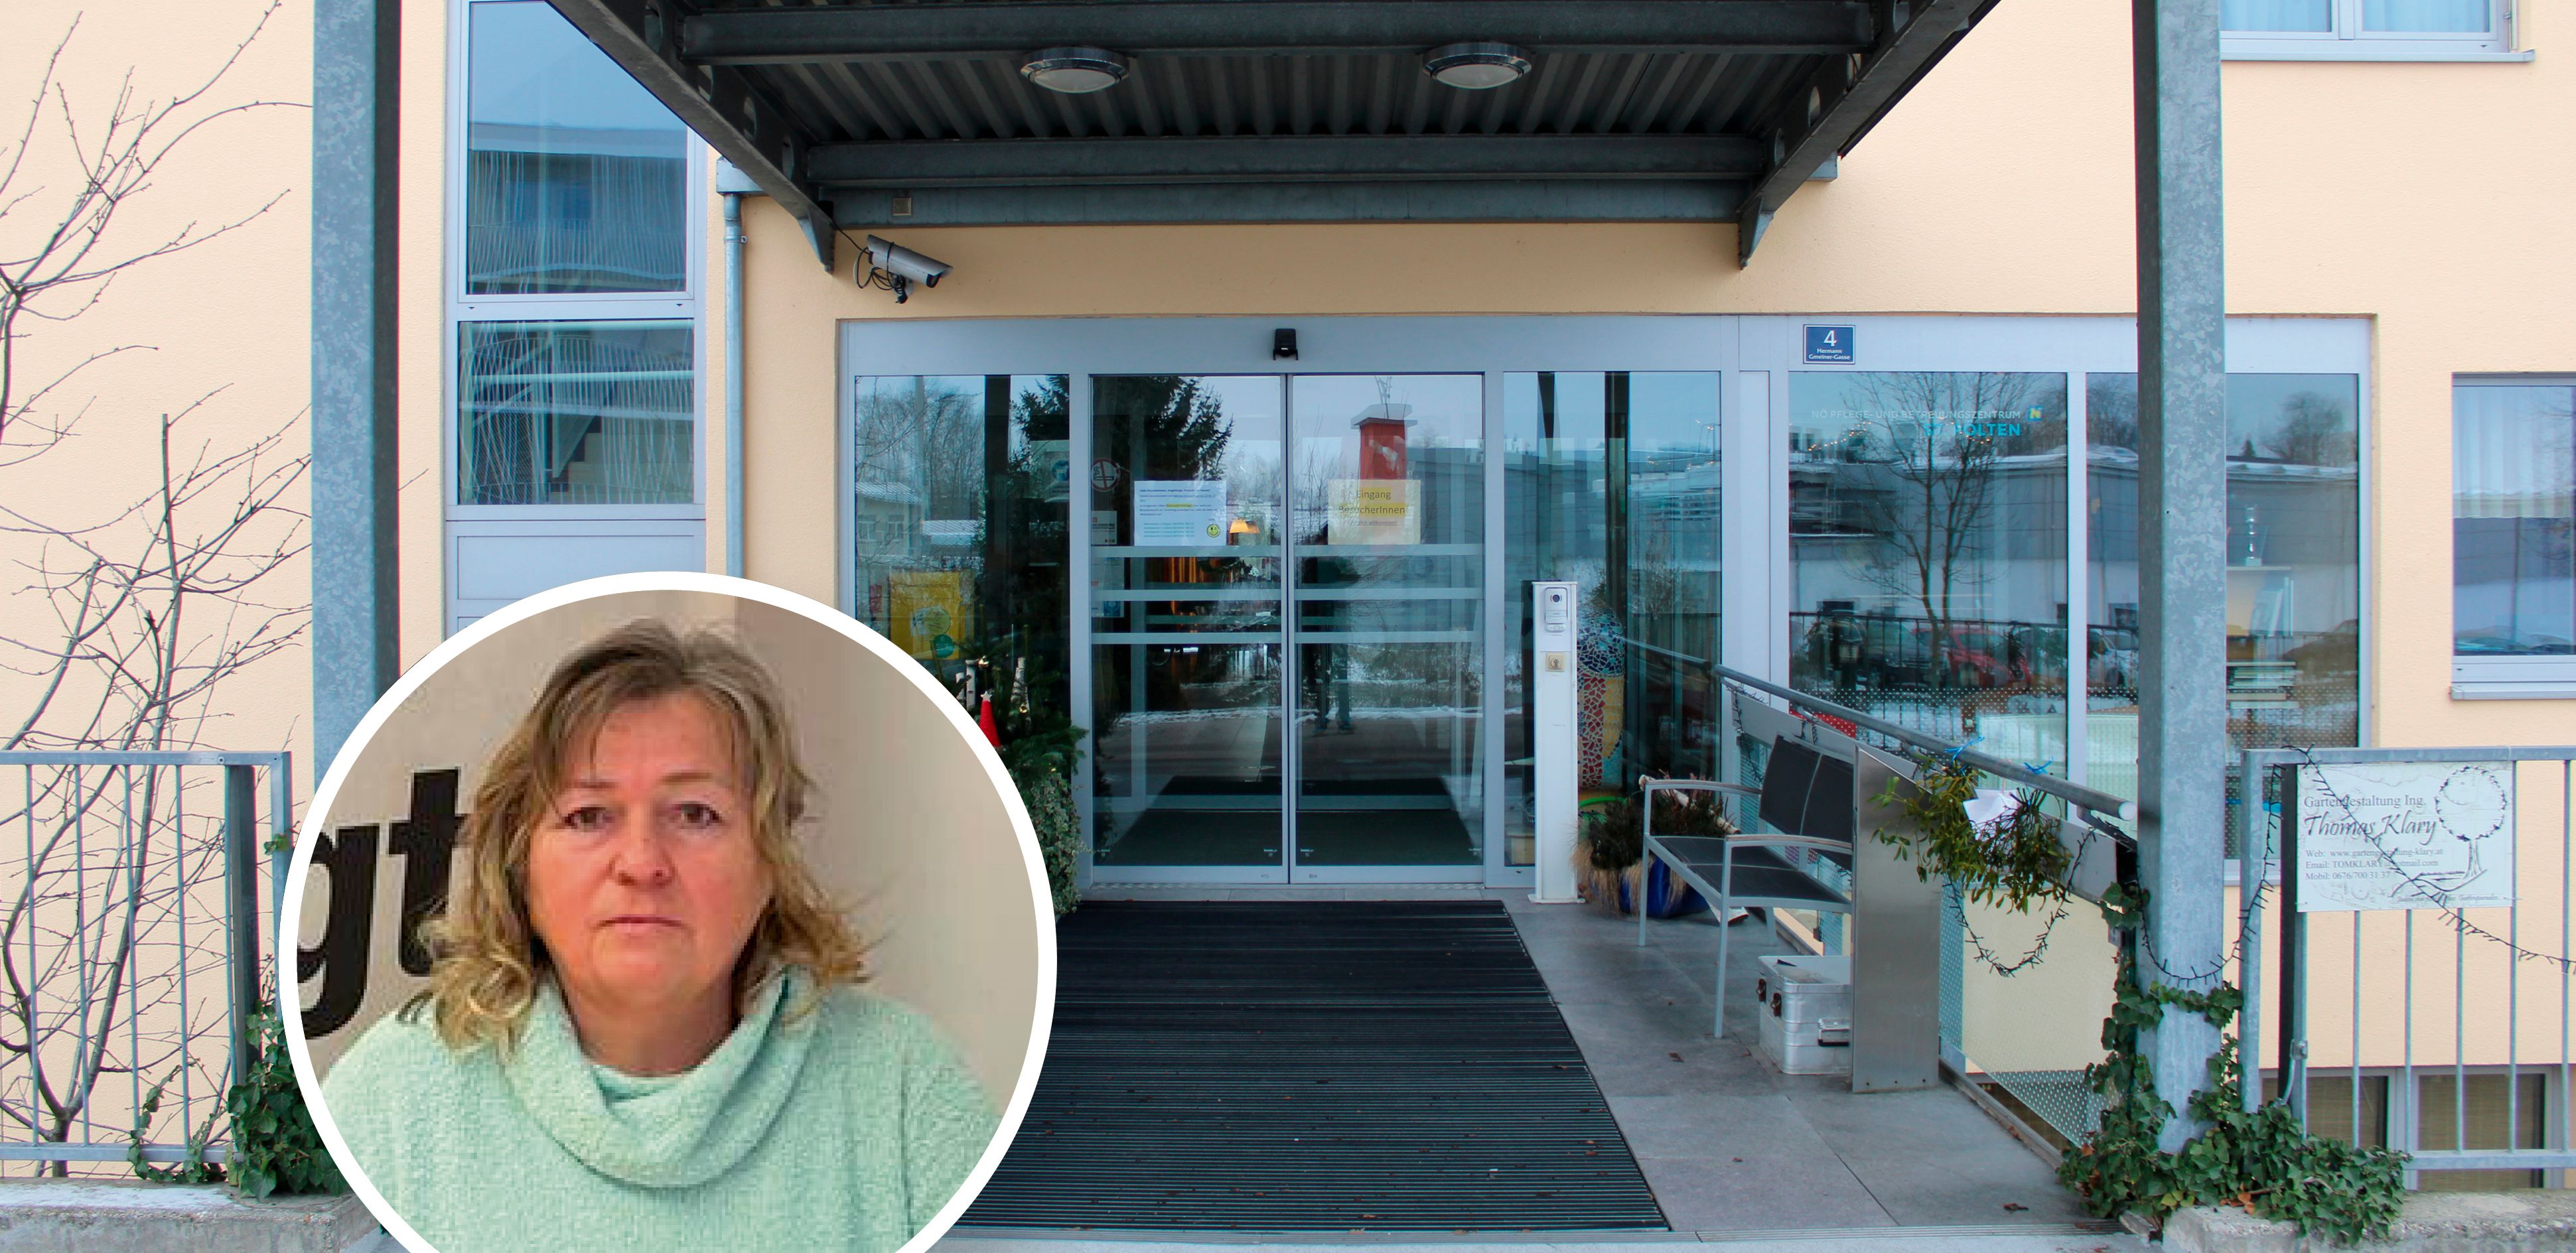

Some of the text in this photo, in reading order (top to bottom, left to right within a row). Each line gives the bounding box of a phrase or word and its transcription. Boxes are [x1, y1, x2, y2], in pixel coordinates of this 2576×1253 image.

[1823, 330, 1837, 347] 4
[1812, 408, 2021, 419] NÖ PFLEGE- UND BETREUUNGSZENTRUM
[1356, 490, 1392, 500] Eingang
[2405, 795, 2427, 809] Ing.
[2304, 810, 2436, 846] Thomas Klary
[2330, 848, 2443, 858] www.gartengttung-klary.at
[2332, 859, 2439, 869] TOMKLARY@otmail.com
[2305, 872, 2330, 880] Mobil:
[2369, 871, 2378, 880] 31
[2380, 870, 2390, 879] 37
